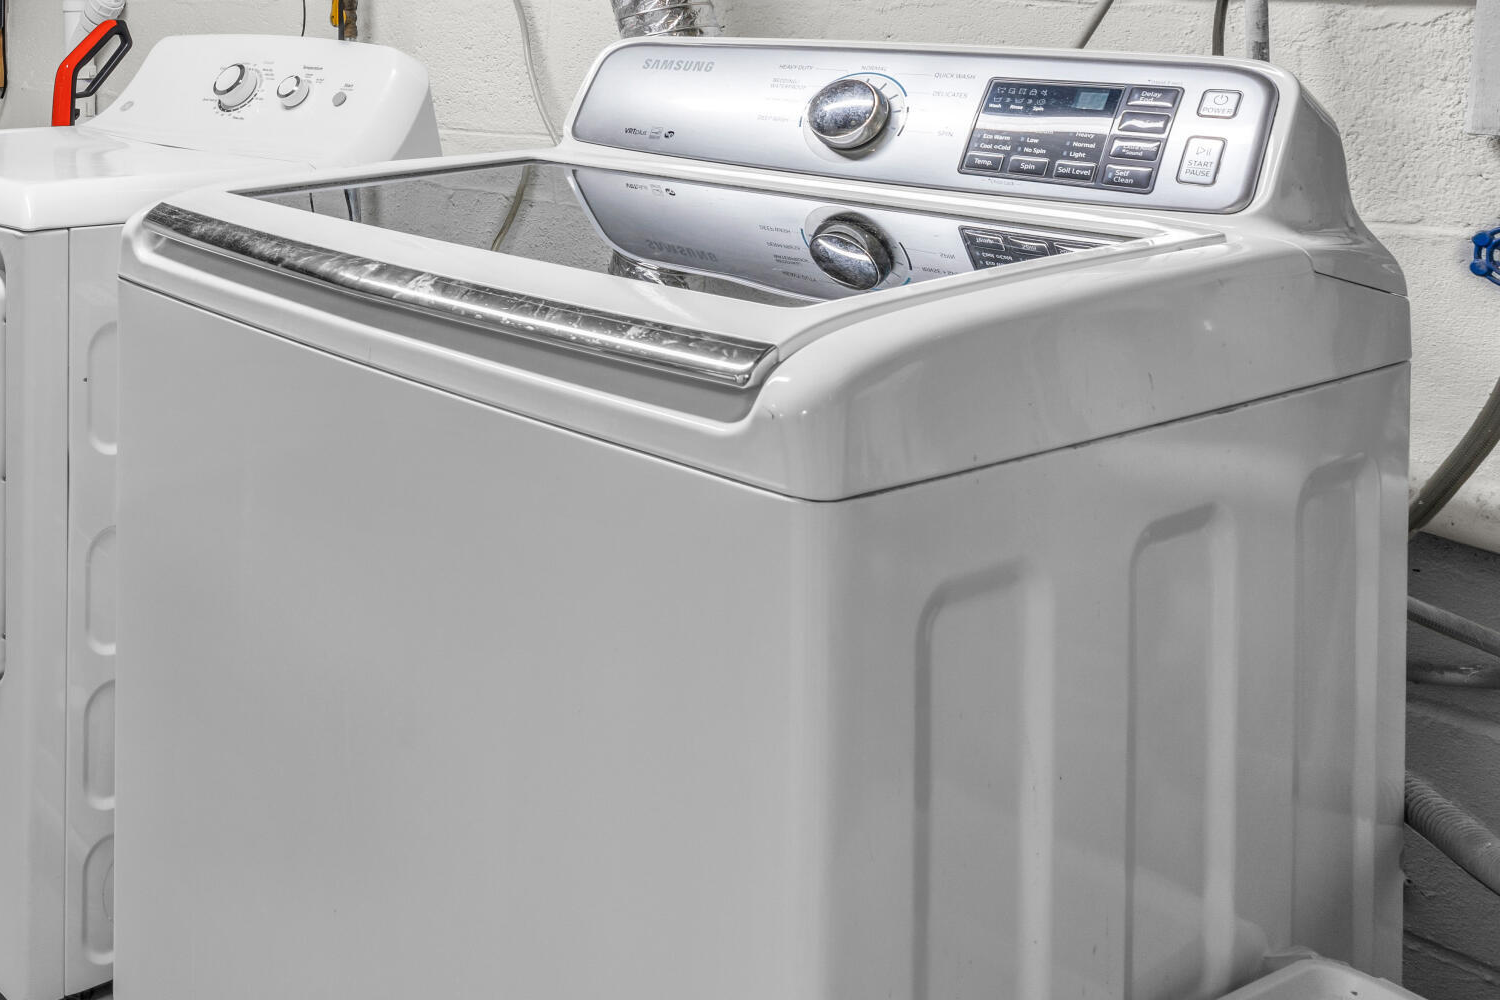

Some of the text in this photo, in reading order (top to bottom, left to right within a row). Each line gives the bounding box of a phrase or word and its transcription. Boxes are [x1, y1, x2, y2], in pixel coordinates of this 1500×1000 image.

[642, 58, 715, 72] SAMSUNG
[1141, 90, 1162, 99] Delay
[1202, 106, 1234, 114] POWER
[1075, 131, 1096, 139] Heavy
[1072, 141, 1096, 149] Normal
[1069, 151, 1086, 159] Light
[974, 158, 993, 166] Temp.
[1020, 162, 1036, 170] Spin
[1187, 159, 1214, 167] START
[1057, 166, 1091, 176] Soil Level
[1115, 169, 1130, 177] Self
[1185, 168, 1211, 177] PAUSE
[1113, 175, 1134, 184] Clean
